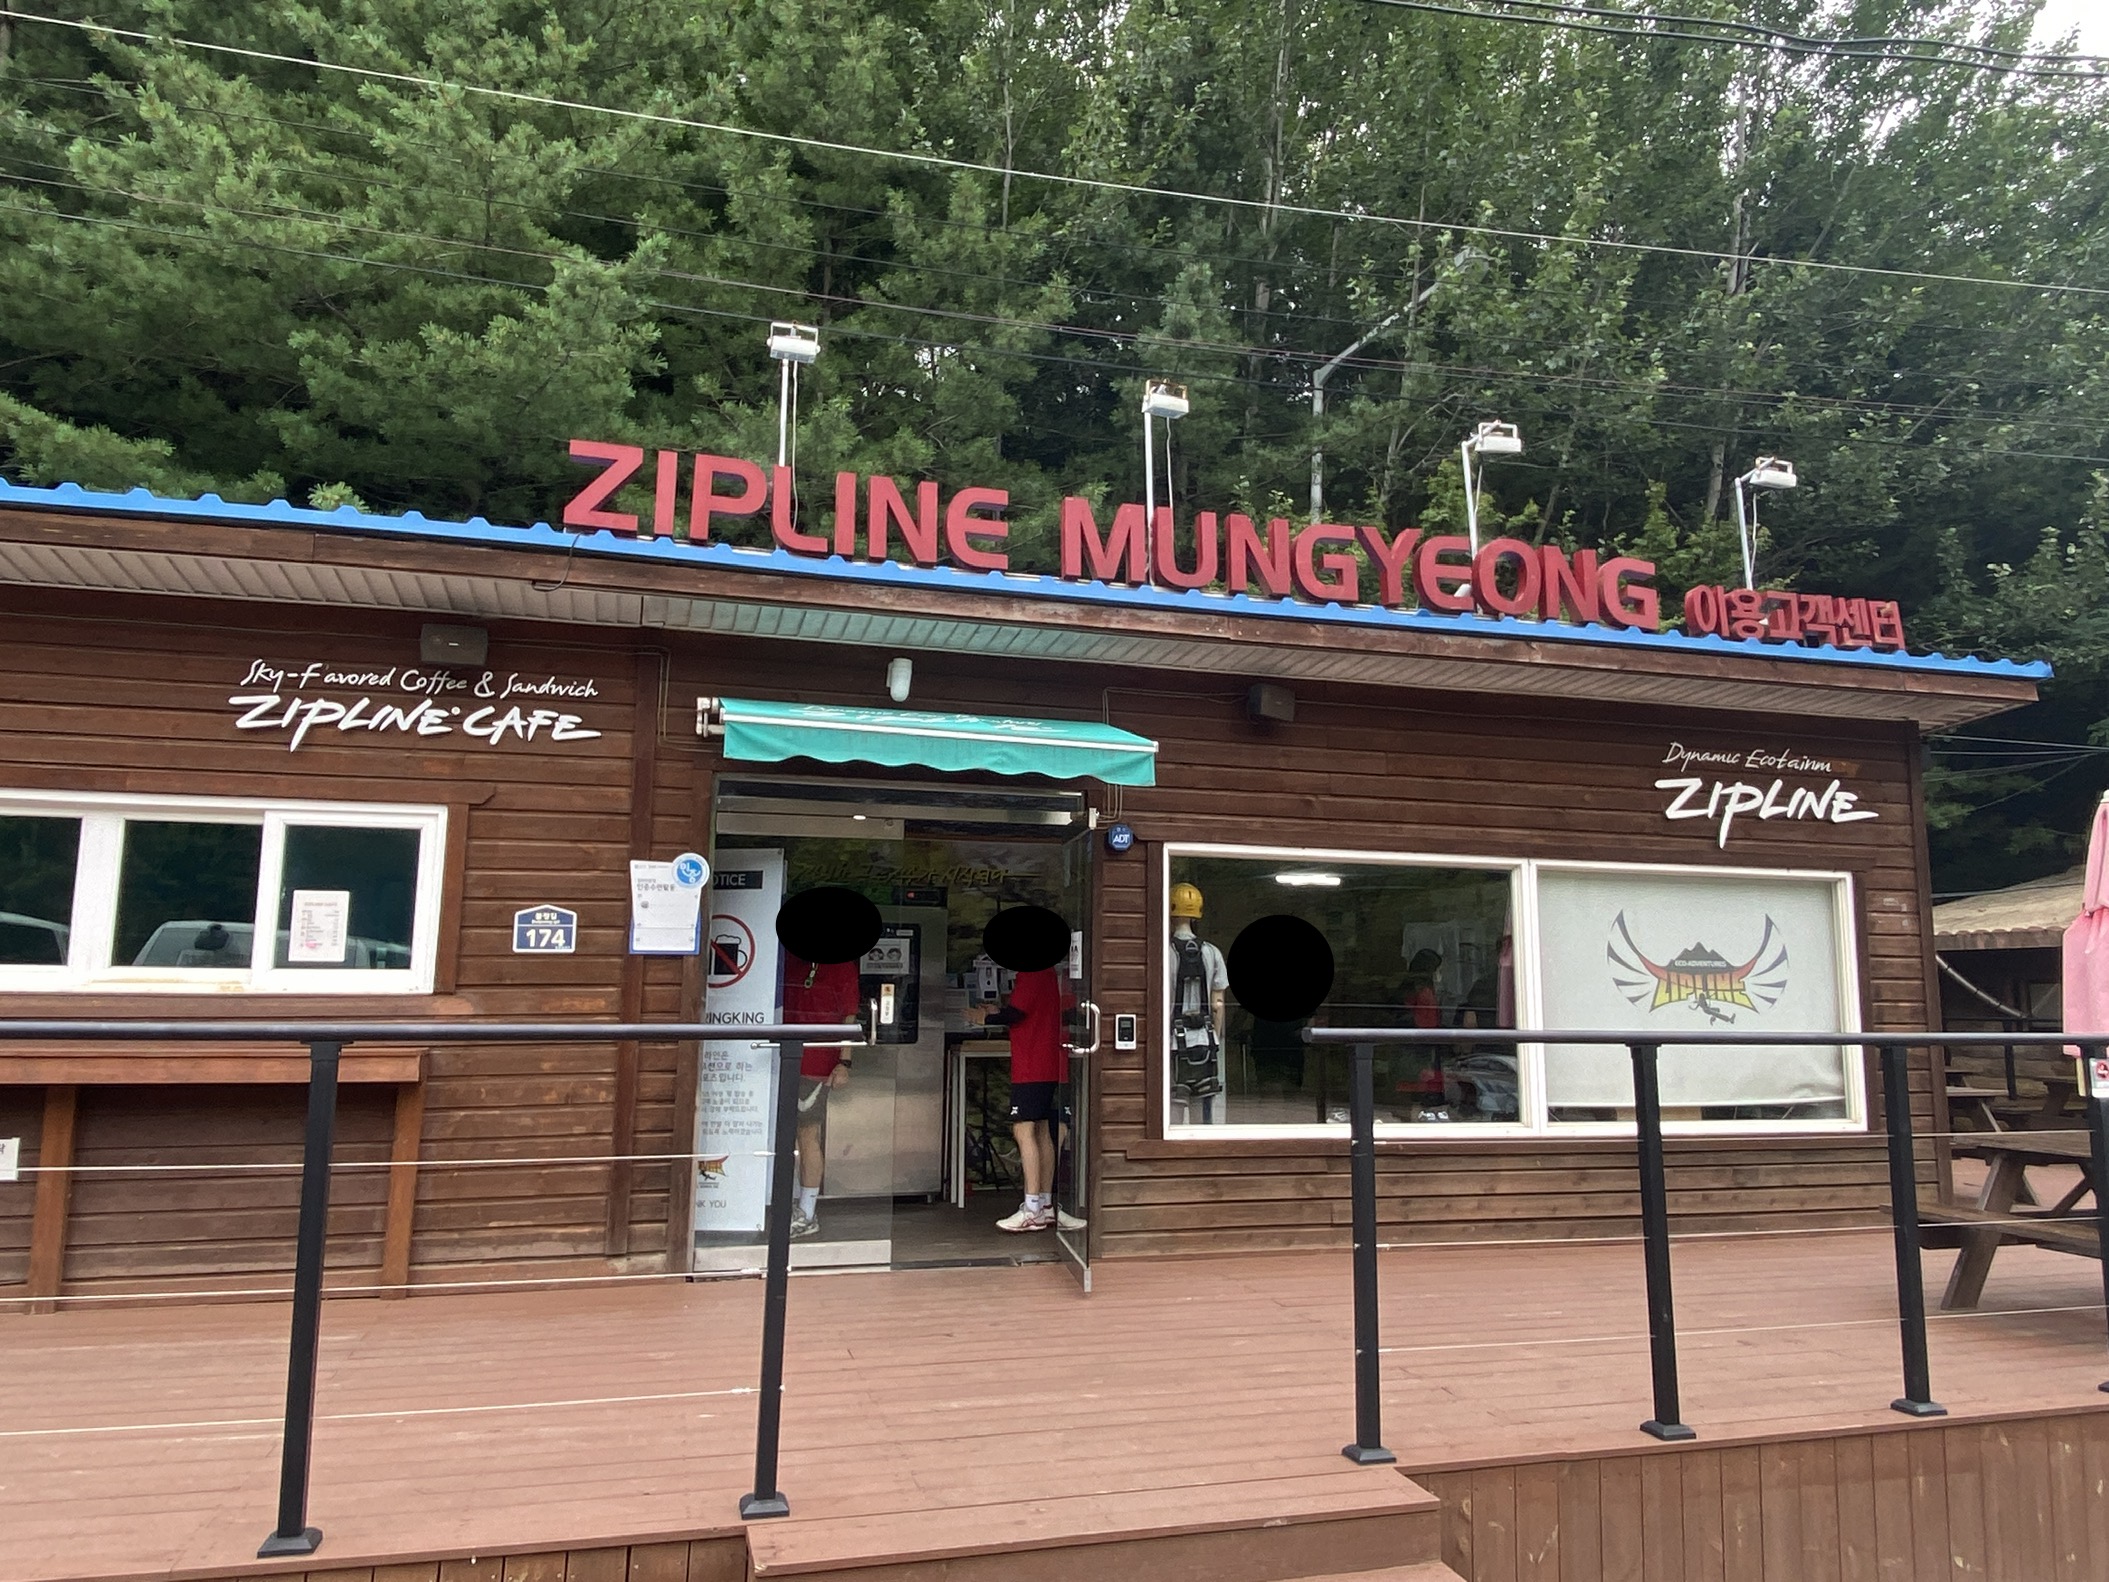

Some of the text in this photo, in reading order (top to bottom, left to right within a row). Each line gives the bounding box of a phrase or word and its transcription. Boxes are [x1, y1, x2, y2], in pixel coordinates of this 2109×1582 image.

[563, 440, 1662, 632] ZIPLINE MUNGYEONG
[400, 669, 468, 695] Coffee
[474, 671, 495, 697] &
[500, 673, 599, 699] Sandwich
[1661, 742, 1740, 772] Dynamic
[1654, 777, 1880, 849] ZIPLINE
[1112, 834, 1130, 844] ADT
[526, 928, 566, 948] 174
[705, 1011, 765, 1024] INGKING
[709, 1199, 727, 1209] YOU
